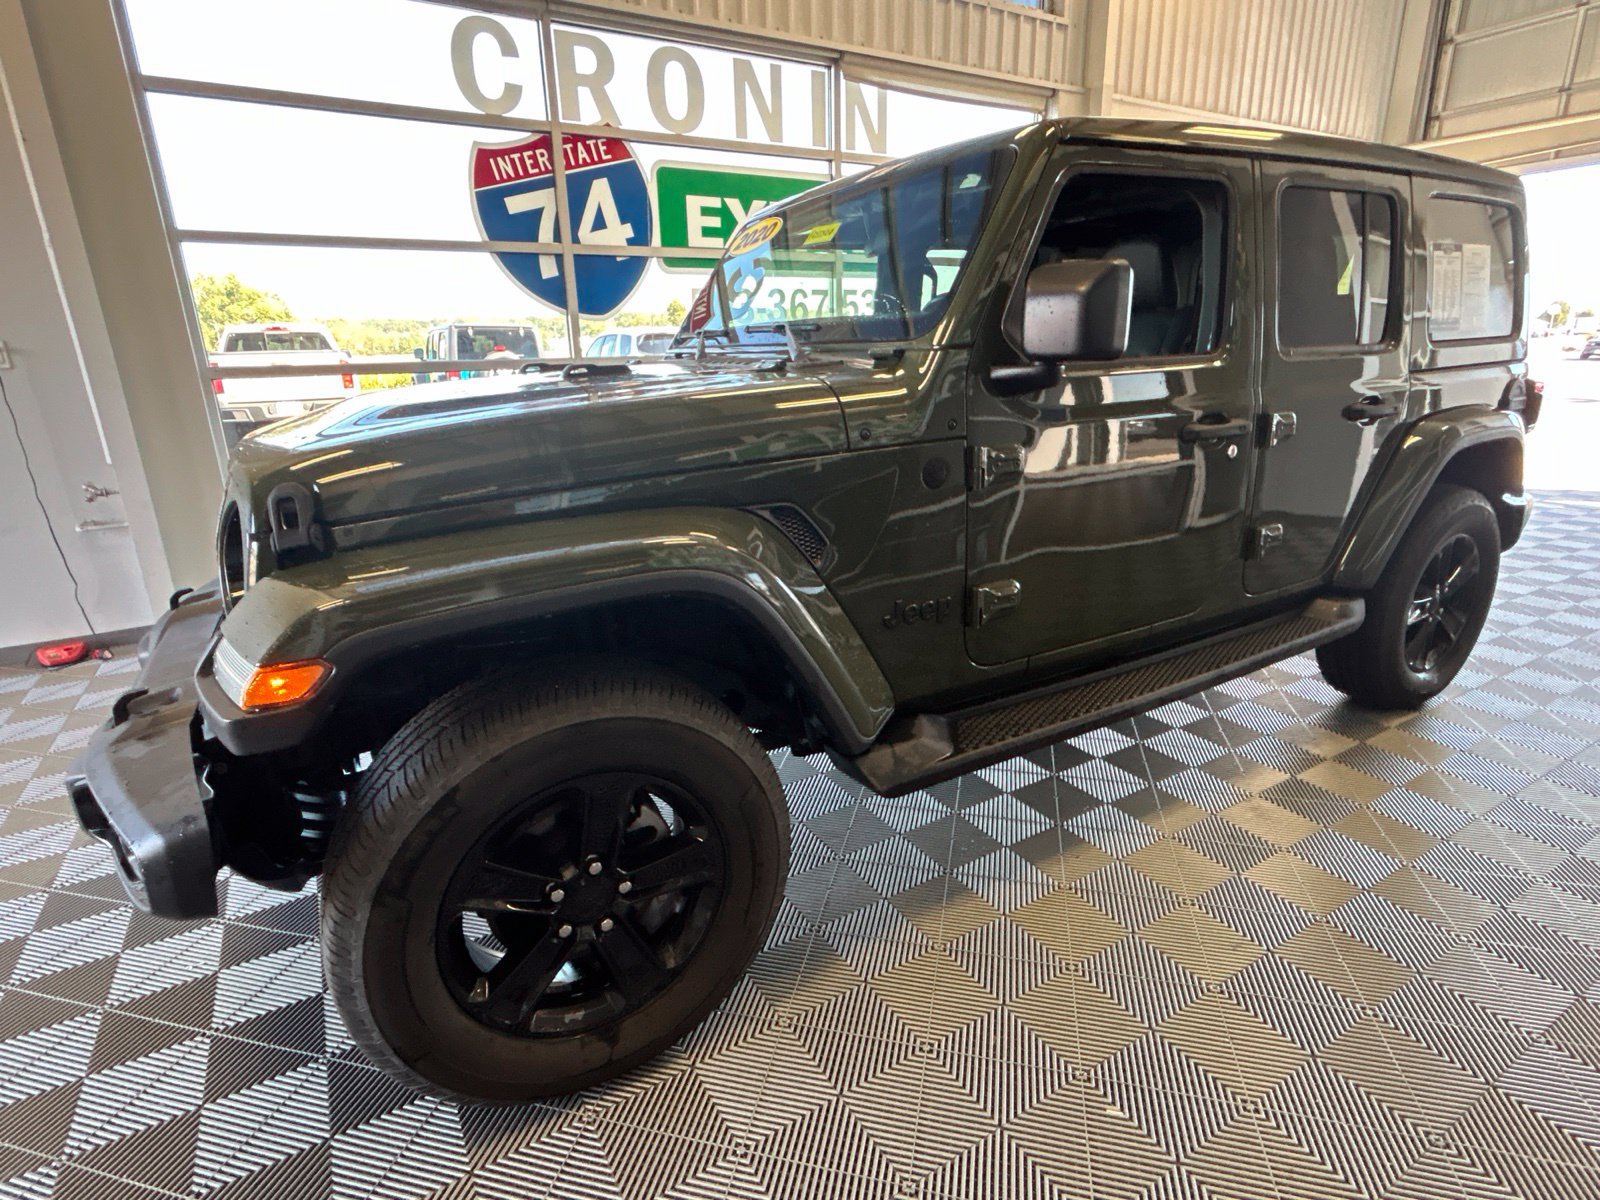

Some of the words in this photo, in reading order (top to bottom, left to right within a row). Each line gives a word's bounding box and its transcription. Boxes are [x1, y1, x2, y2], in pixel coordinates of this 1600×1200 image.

[450, 15, 888, 154] CRONIN
[489, 139, 612, 182] INTERTATE
[503, 177, 635, 280] 74
[686, 195, 780, 249] EX
[732, 221, 780, 253] 2020
[882, 596, 953, 629] Jeep
